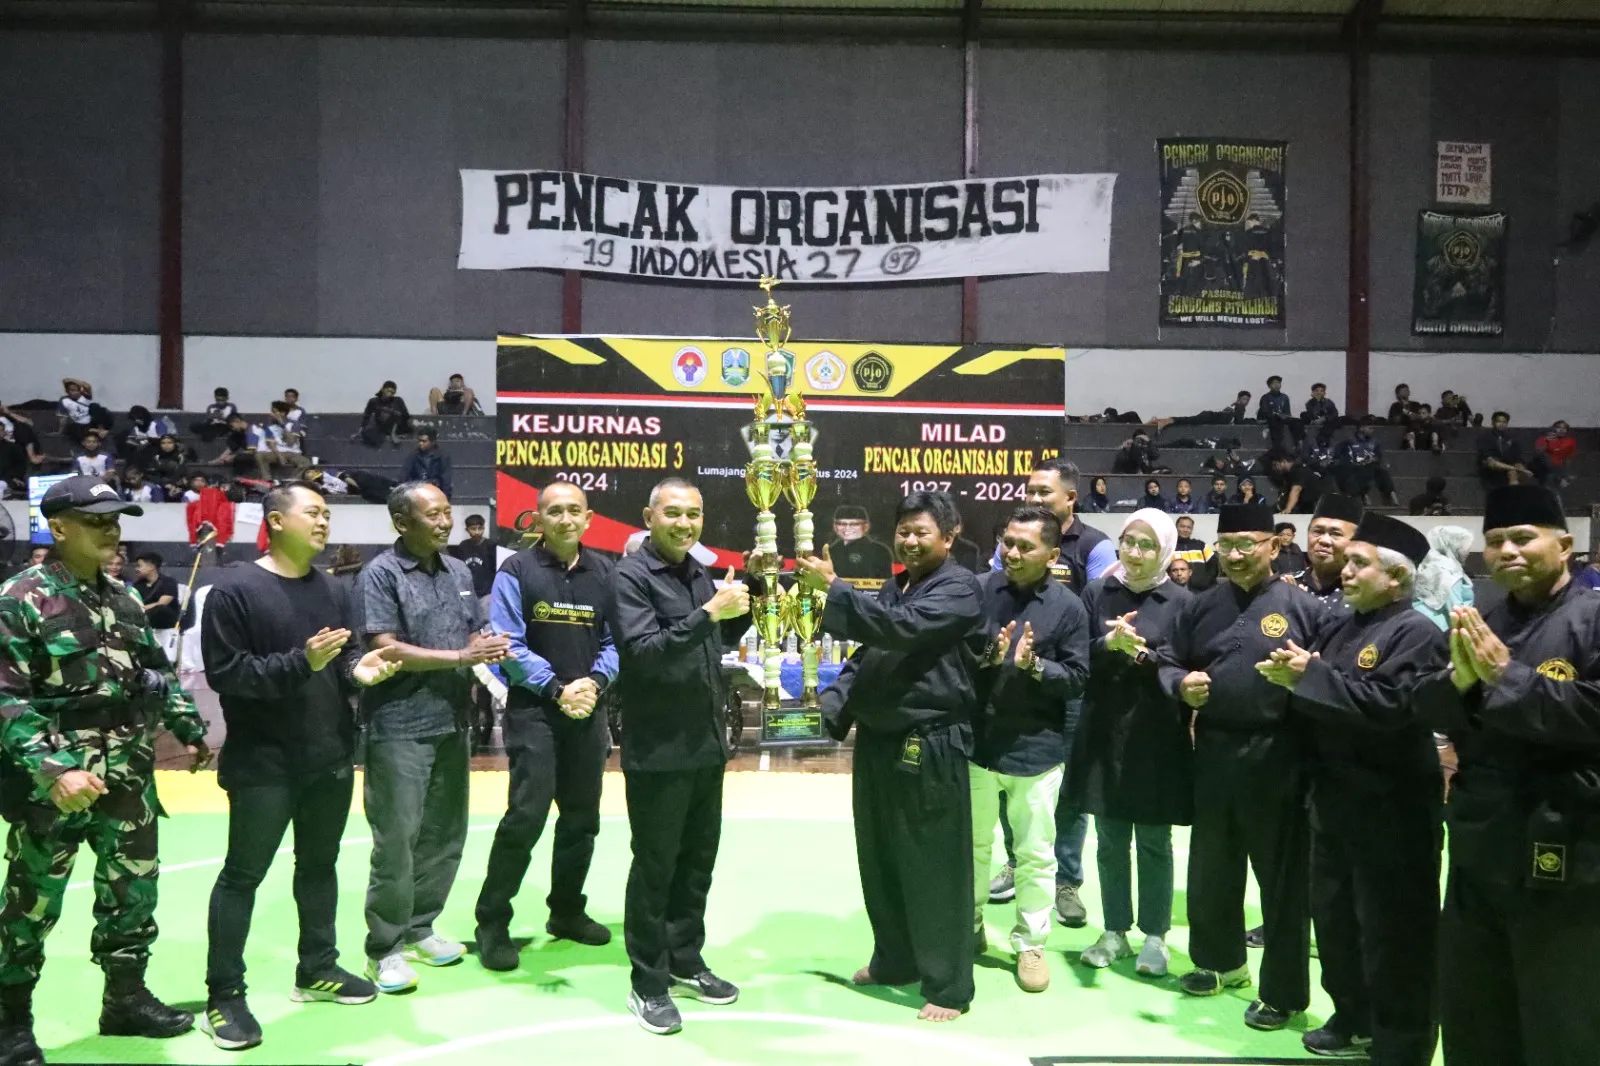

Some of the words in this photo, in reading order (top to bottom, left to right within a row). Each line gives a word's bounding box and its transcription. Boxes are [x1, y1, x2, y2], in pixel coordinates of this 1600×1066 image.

[493, 172, 699, 242] PENCAK
[731, 180, 1039, 246] ORGANISASI
[583, 238, 615, 267] 19
[629, 245, 798, 280] INDONESIA
[807, 247, 861, 279] 27
[885, 248, 916, 274] 97
[512, 413, 661, 435] KEJURNAS
[921, 423, 1006, 443] MILAD
[496, 439, 563, 466] PENCAK
[566, 441, 667, 468] ORGANISASI
[674, 441, 683, 469] 3
[864, 447, 921, 473] PENCAK
[923, 448, 1008, 475] ORGANISASI
[1013, 450, 1033, 475] KE
[698, 466, 746, 478] Lumajang
[834, 469, 858, 478] 2024
[975, 482, 1028, 501] 2024
